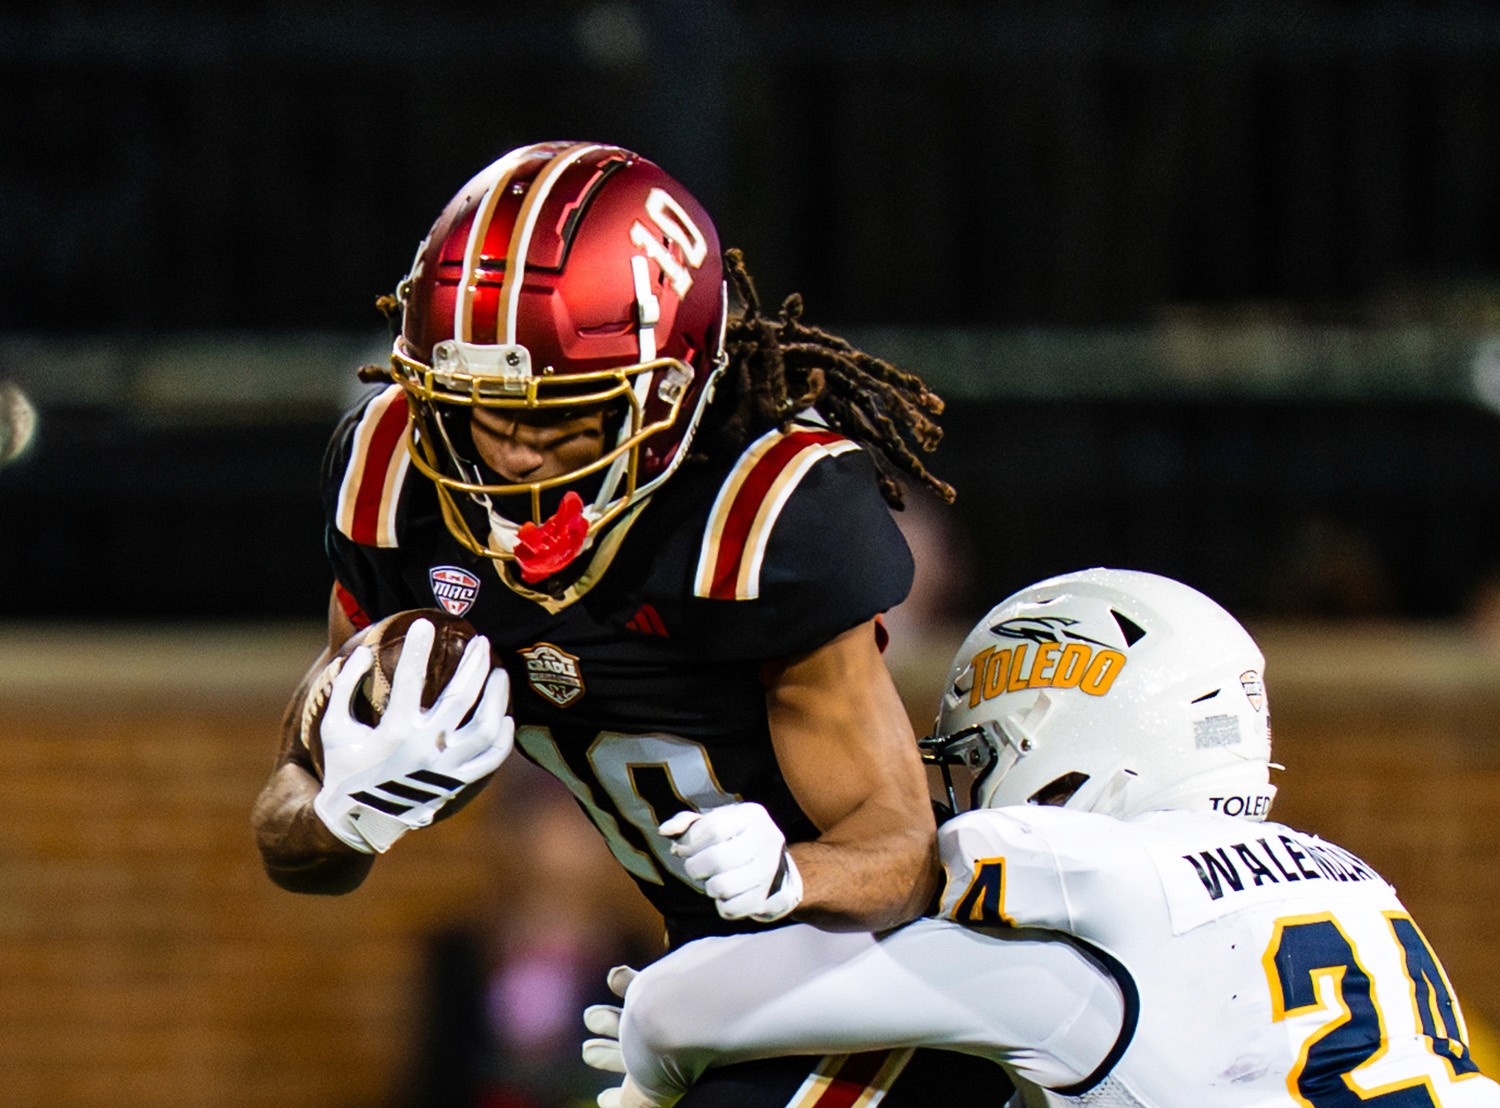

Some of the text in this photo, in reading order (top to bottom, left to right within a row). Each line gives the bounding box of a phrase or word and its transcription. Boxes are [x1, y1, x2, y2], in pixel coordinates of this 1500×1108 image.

[630, 188, 707, 300] 10
[969, 642, 1127, 709] TOLEDO
[515, 725, 744, 896] 10
